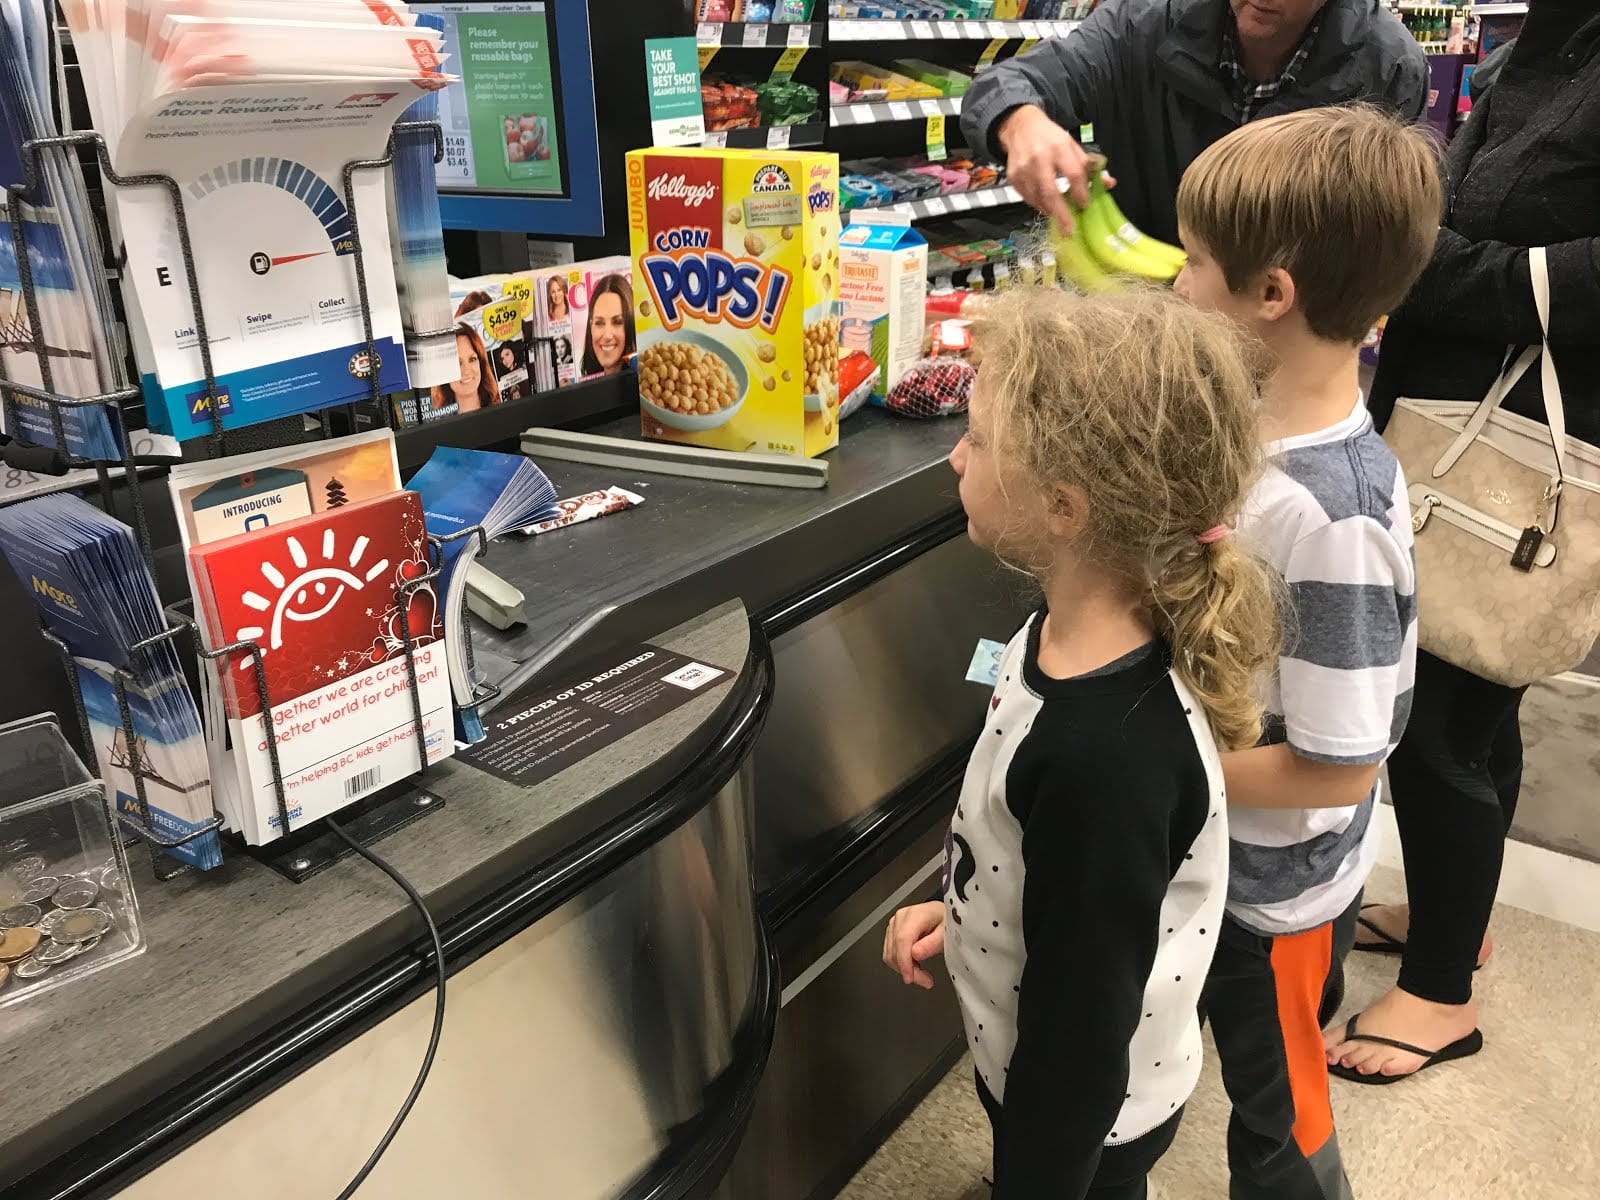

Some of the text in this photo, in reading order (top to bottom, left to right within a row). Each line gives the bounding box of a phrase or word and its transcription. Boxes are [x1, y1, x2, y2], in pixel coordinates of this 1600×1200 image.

[468, 27, 497, 37] Please
[470, 39, 539, 51] remember your
[471, 51, 533, 63] reusable bags
[650, 49, 672, 62] TAKE
[651, 62, 675, 74] YOUR
[652, 73, 696, 87] BEST SHOT
[654, 88, 675, 96] AGAINST
[168, 99, 218, 107] Now
[221, 97, 251, 105] fill
[252, 97, 278, 105] up
[157, 103, 324, 117] More Rewards at
[445, 137, 465, 146] $1.49
[649, 173, 716, 207] Kellogg's
[753, 184, 791, 193] CANADA
[628, 159, 644, 233] JUMBO
[808, 190, 835, 215] POPS!
[656, 229, 710, 253] CORN
[156, 266, 172, 287] E
[642, 252, 791, 332] POPS!
[839, 282, 884, 292] actose Free
[318, 297, 346, 309] Collect
[839, 292, 886, 303] ans Lactose
[246, 313, 272, 325] Swipe
[489, 310, 517, 329] $4.99
[174, 327, 196, 339] Link
[192, 395, 230, 414] Mre
[401, 396, 431, 409] PIONER
[222, 494, 282, 519] INTRODUCING
[496, 651, 656, 730] 2 PIECES OF ID REQUIRED
[256, 697, 322, 728] Tgether
[326, 685, 348, 701] we
[350, 674, 373, 692] are
[320, 699, 359, 725] world
[362, 691, 382, 708] for
[301, 759, 339, 784] helping
[339, 753, 354, 768] BC
[355, 745, 374, 760] kids
[376, 737, 393, 753] get
